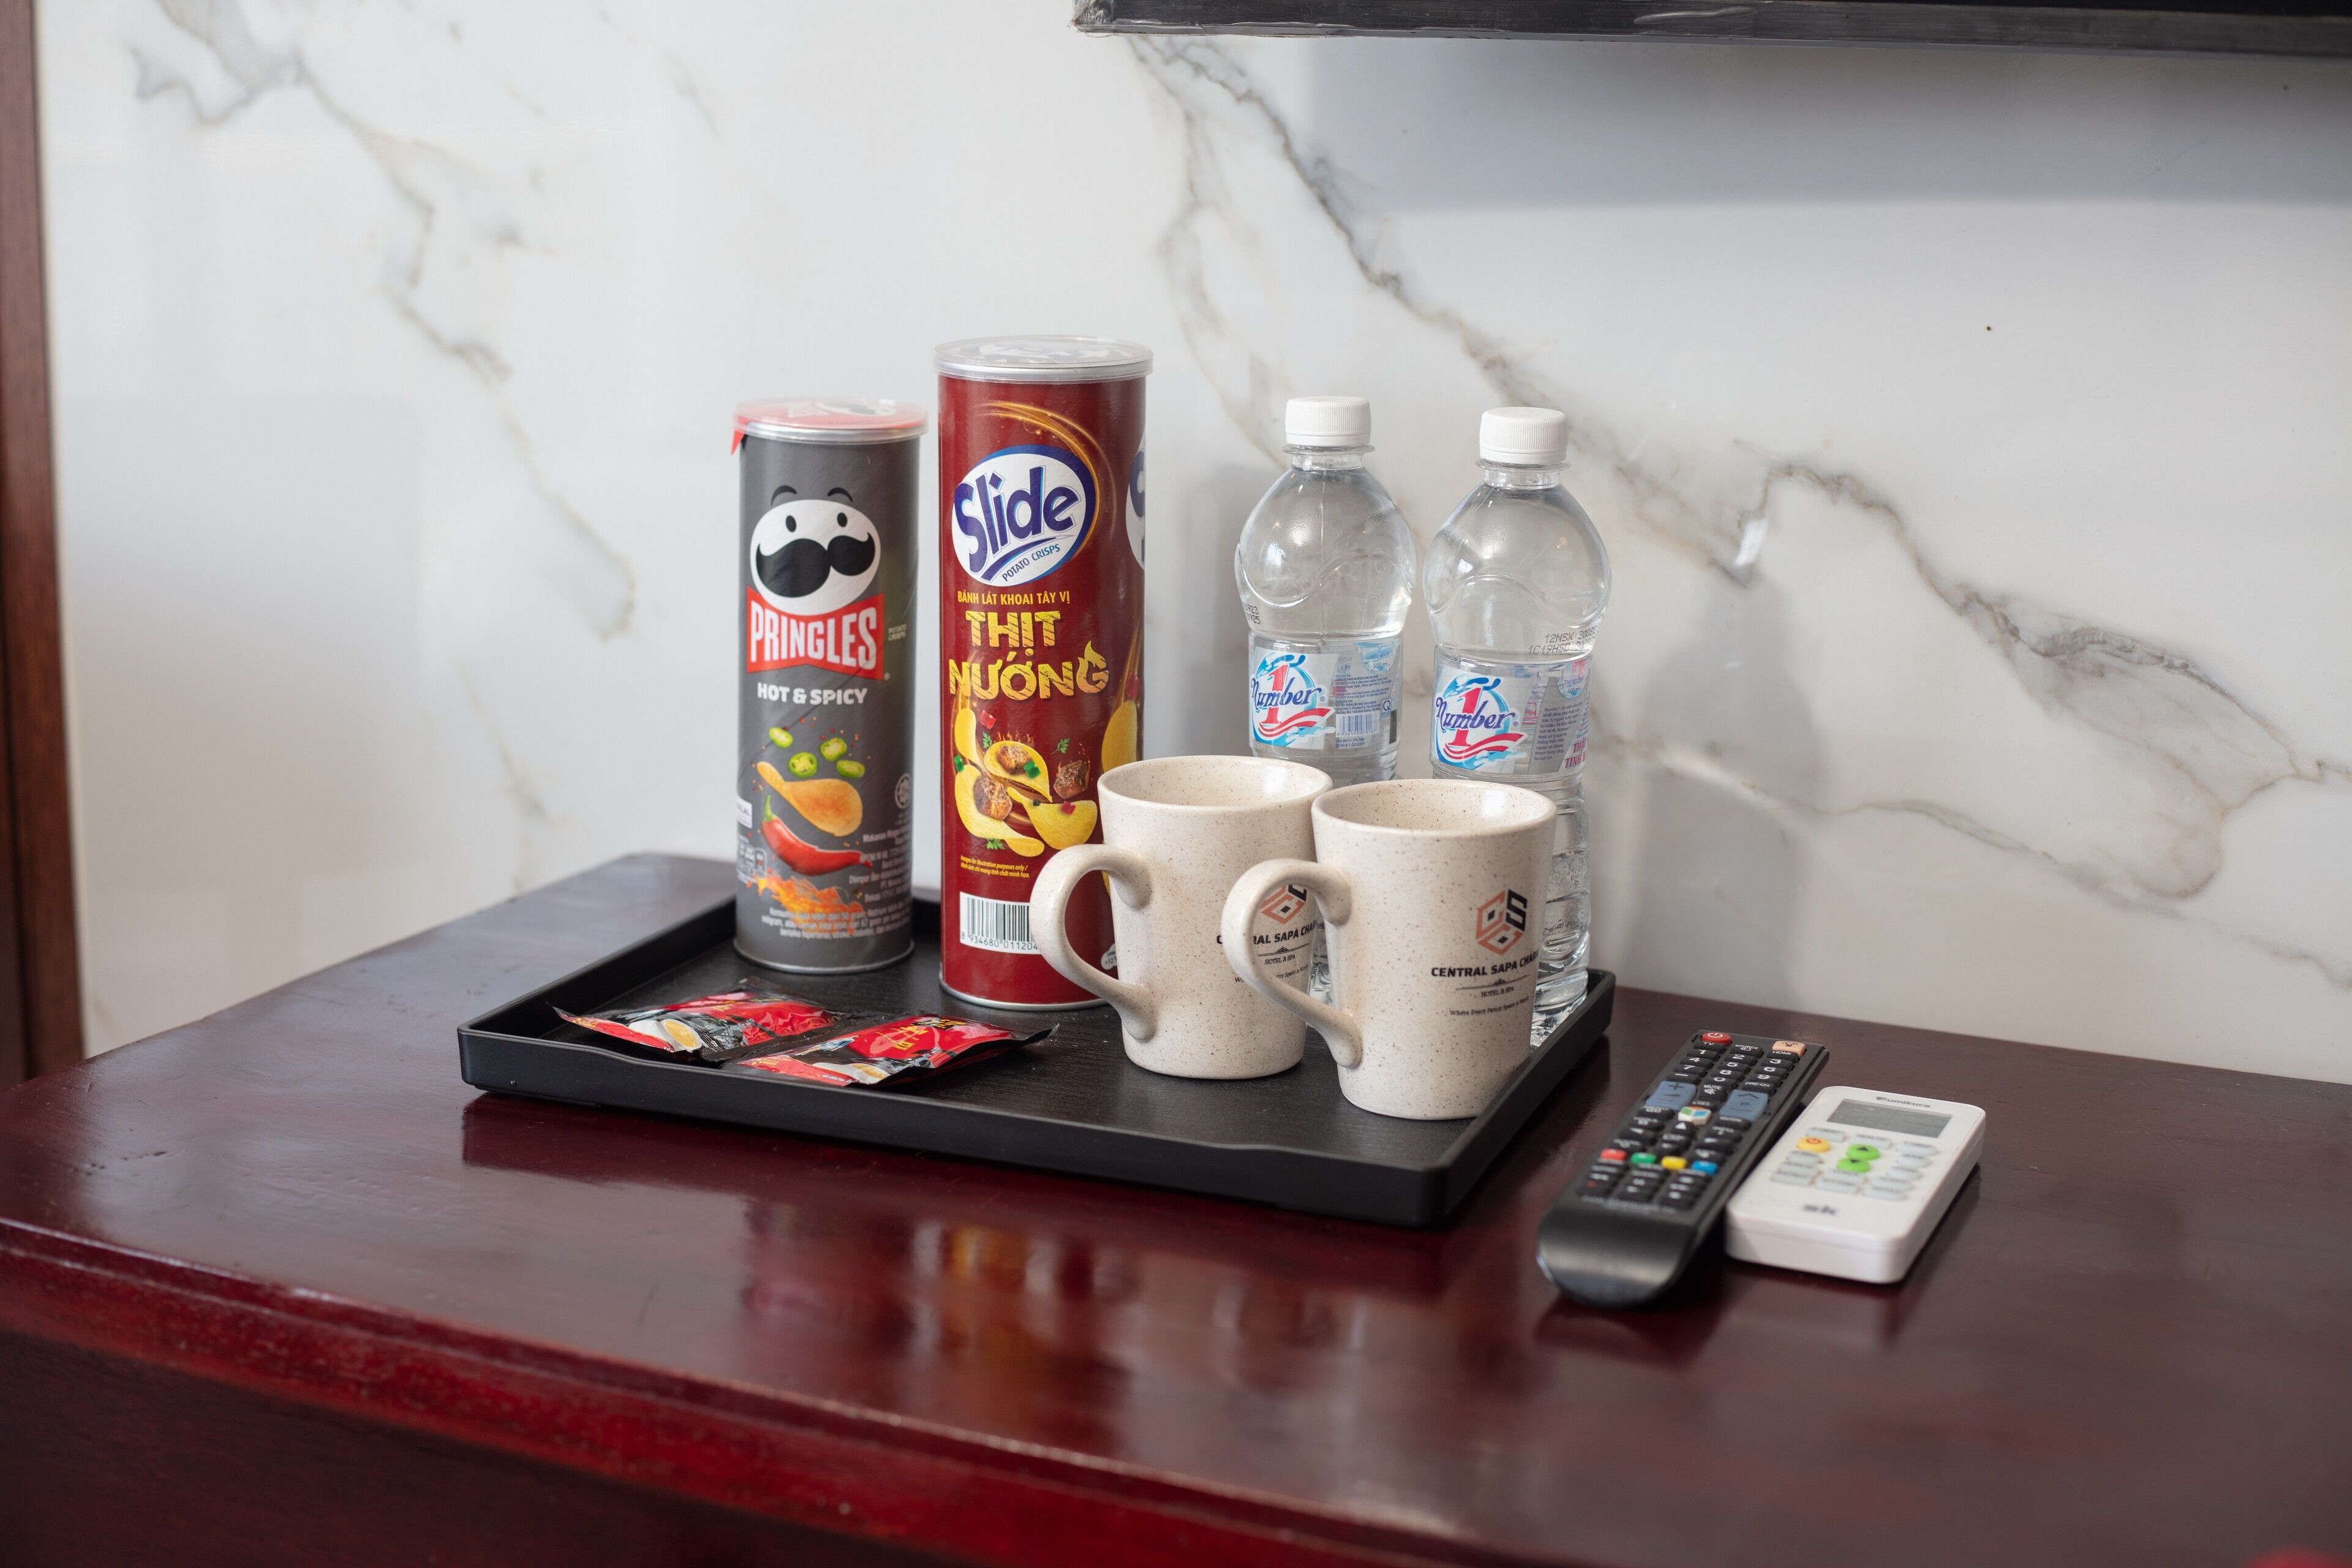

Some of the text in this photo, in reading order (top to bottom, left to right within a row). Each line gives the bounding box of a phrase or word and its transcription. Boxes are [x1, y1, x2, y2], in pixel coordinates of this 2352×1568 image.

[954, 466, 1080, 573] Slide
[1001, 543, 1061, 582] POTATO CRISPS
[957, 589, 1070, 605] BÁNH LÁT KHOAI TÂY VỊ
[750, 600, 877, 670] PRINGLES
[965, 610, 1061, 657] THỊT
[949, 641, 1109, 701] NƯỚNG
[757, 682, 868, 705] HOT & SPICY
[1251, 677, 1322, 710] Number
[1436, 697, 1516, 733] Number
[970, 934, 999, 948] 934680
[1003, 940, 1038, 951] 011204
[1274, 929, 1299, 943] SAPA
[1431, 967, 1487, 978] CENTRAL
[1491, 960, 1517, 974] SAPA
